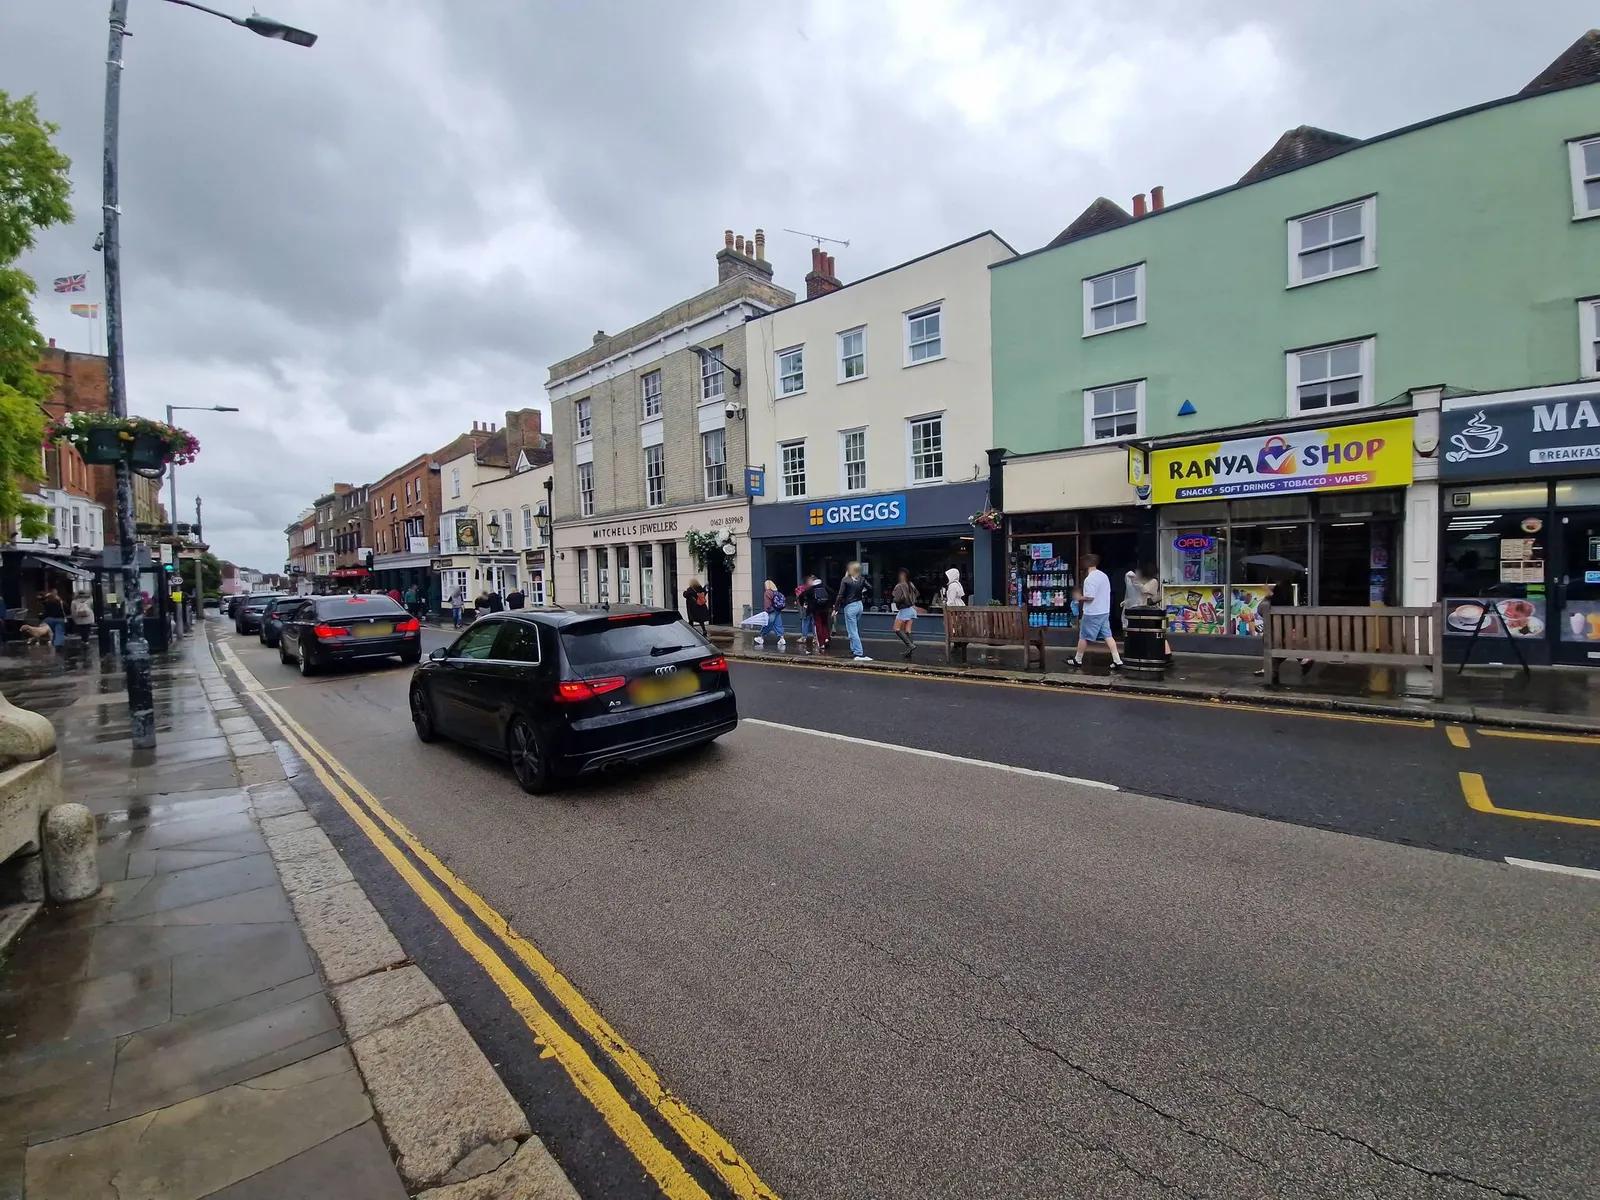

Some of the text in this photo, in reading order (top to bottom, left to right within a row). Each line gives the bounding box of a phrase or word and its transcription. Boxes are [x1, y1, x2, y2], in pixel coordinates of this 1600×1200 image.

[1169, 454, 1254, 479] RANYA
[1302, 438, 1385, 467] SHOP
[1181, 474, 1368, 497] SNACKS SOFT DRINKS TOBACCO VAPES
[710, 516, 744, 526] 01621 859969
[826, 501, 900, 524] GREGGS
[593, 521, 678, 538] MITCHELLS JEWELLERS
[1178, 538, 1209, 548] OPEN
